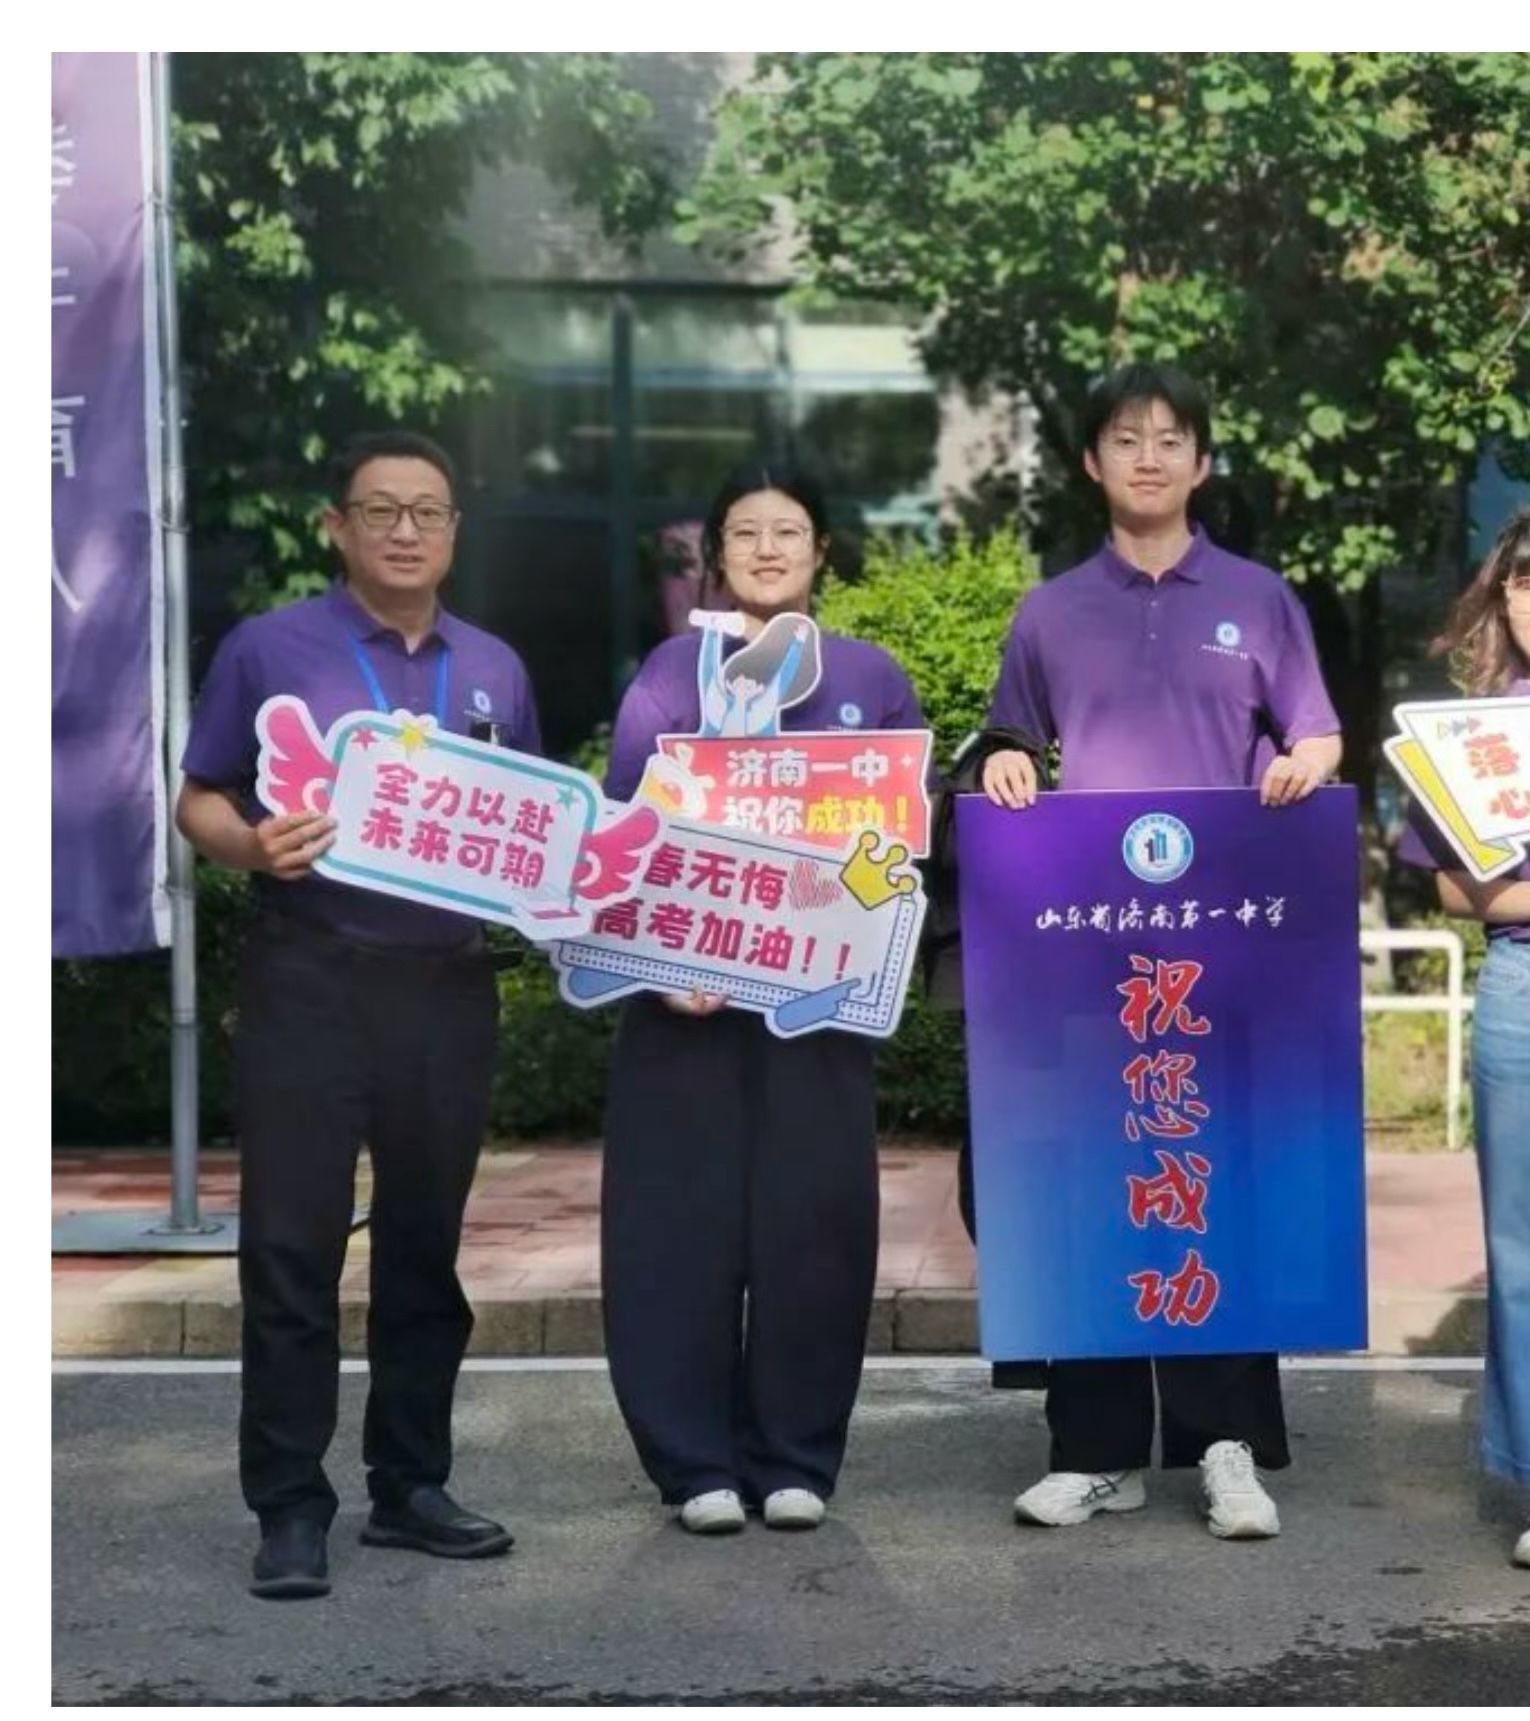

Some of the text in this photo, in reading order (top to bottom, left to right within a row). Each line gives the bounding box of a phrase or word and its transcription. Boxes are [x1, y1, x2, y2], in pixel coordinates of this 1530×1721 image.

[726, 748, 890, 788] 济南一中
[373, 762, 555, 845] 全力以赴
[721, 794, 908, 835] 祝你成功！
[359, 806, 546, 889] 未来可期
[1036, 896, 1285, 933] 山东省济南第一中学
[1116, 954, 1218, 1326] 祝您成功
